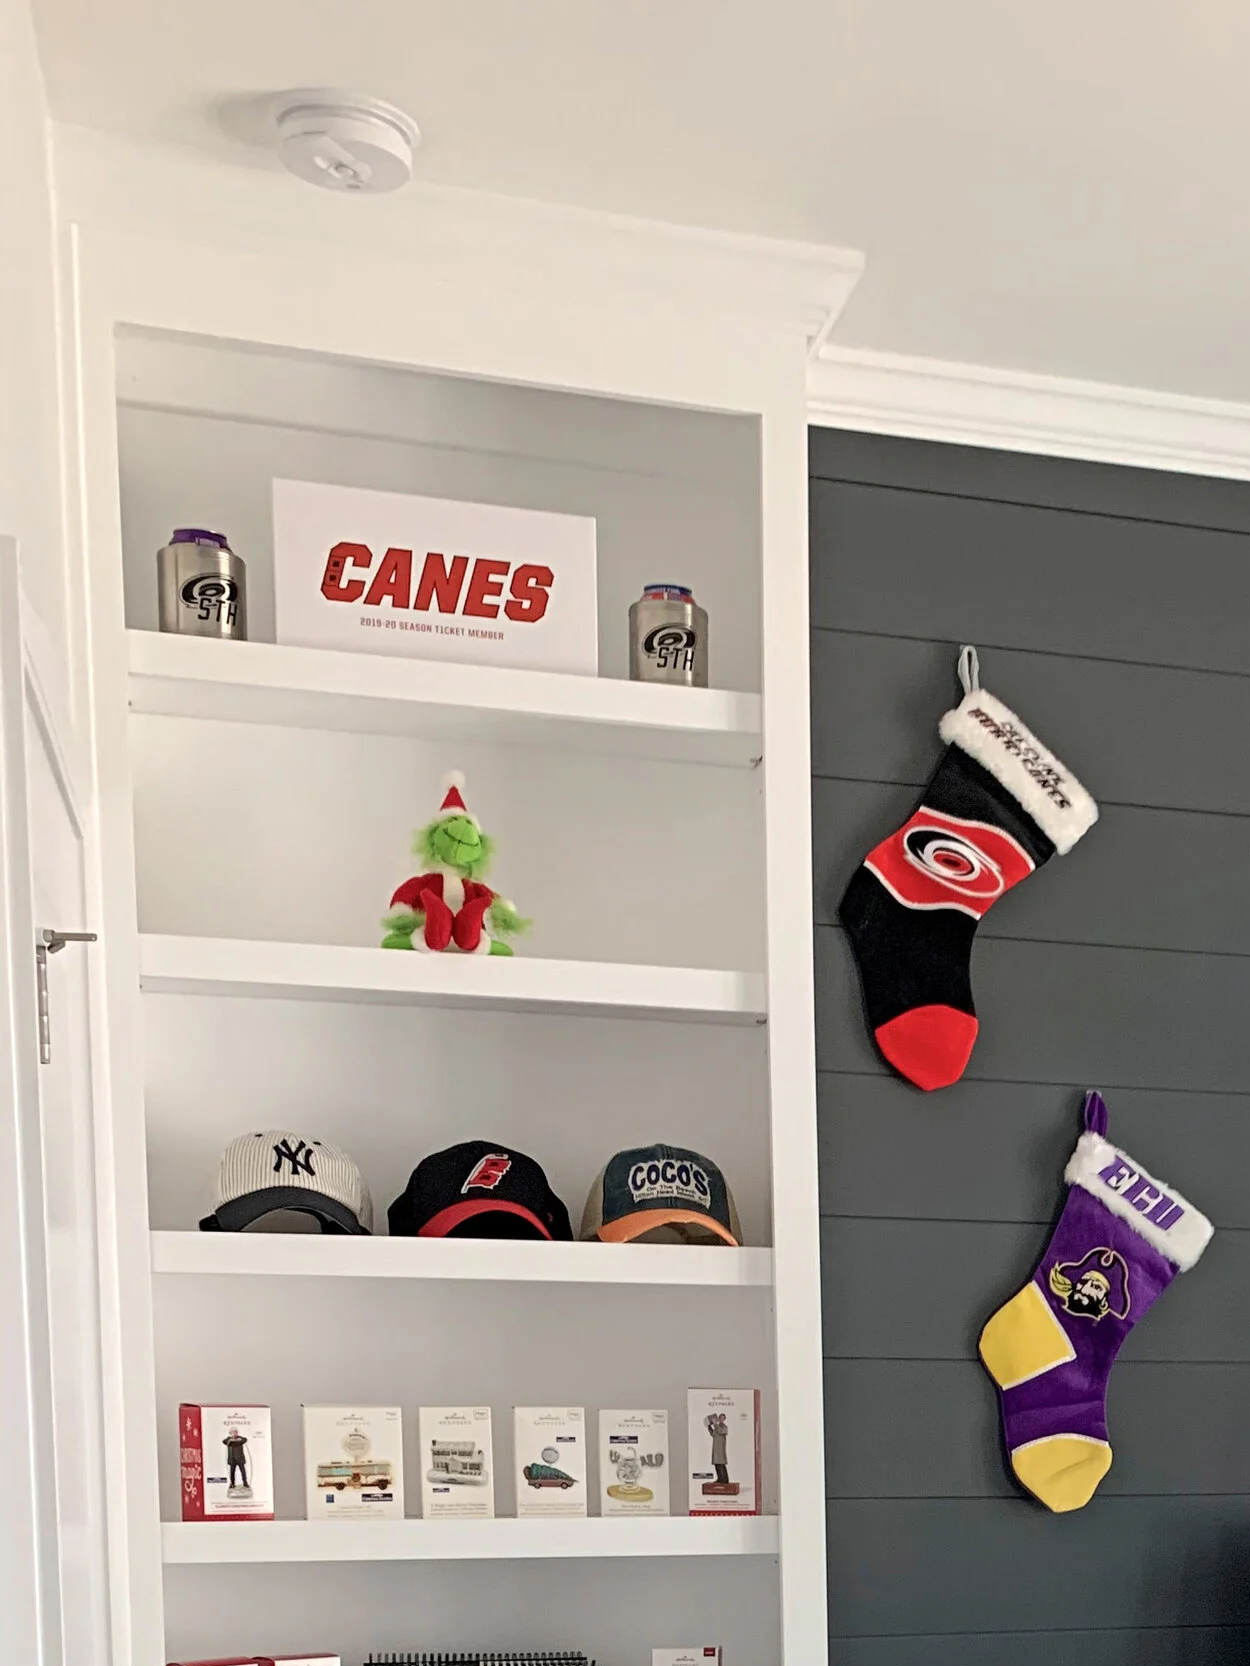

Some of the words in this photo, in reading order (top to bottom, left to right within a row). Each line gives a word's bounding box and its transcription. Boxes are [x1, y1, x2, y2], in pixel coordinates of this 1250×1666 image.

[320, 541, 555, 623] CANES
[197, 597, 238, 627] STH
[360, 617, 397, 631] 2019-20
[399, 621, 432, 634] SEASON
[435, 625, 465, 637] TICKET
[467, 629, 505, 641] MEMBER
[656, 647, 695, 671] STH
[273, 1138, 316, 1177] NY
[631, 1161, 708, 1196] COCO'S
[1097, 1154, 1185, 1231] ECU
